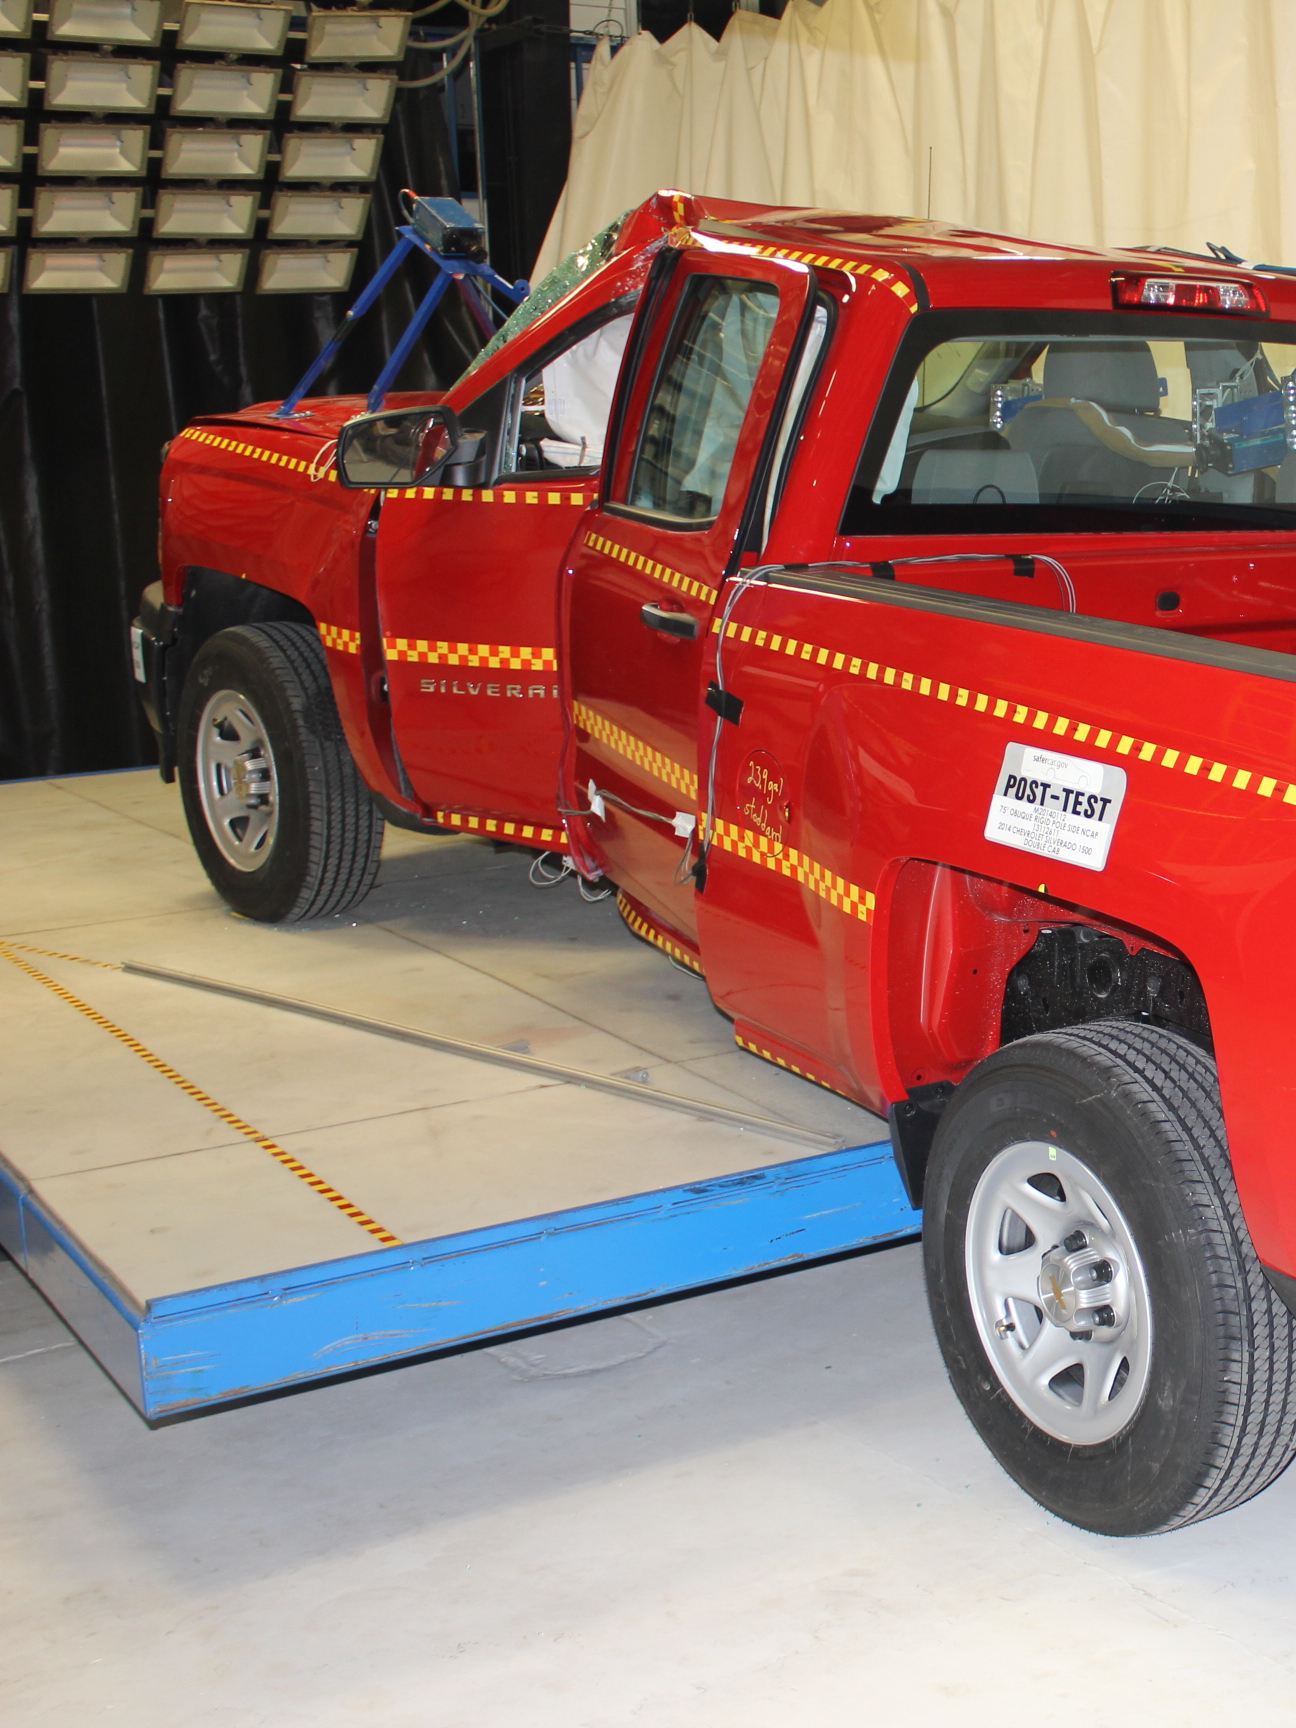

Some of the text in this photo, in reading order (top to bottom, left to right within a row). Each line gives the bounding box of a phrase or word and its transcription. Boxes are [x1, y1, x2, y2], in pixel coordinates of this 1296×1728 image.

[1033, 754, 1069, 769] safercar.gov
[1003, 774, 1112, 821] POST-TEST
[1033, 807, 1066, 821] M20140112
[1010, 808, 1033, 821] OBLIQUE
[1034, 815, 1050, 826] RIGID
[1052, 820, 1067, 831] POLE
[1067, 824, 1080, 835] SIDE
[1081, 828, 1099, 839] NCAP
[1033, 823, 1059, 837] 13112611
[997, 822, 1093, 856] 2014 CHEVROLET SILVERADO 1500
[1024, 838, 1060, 855] DOUBLE CAB
